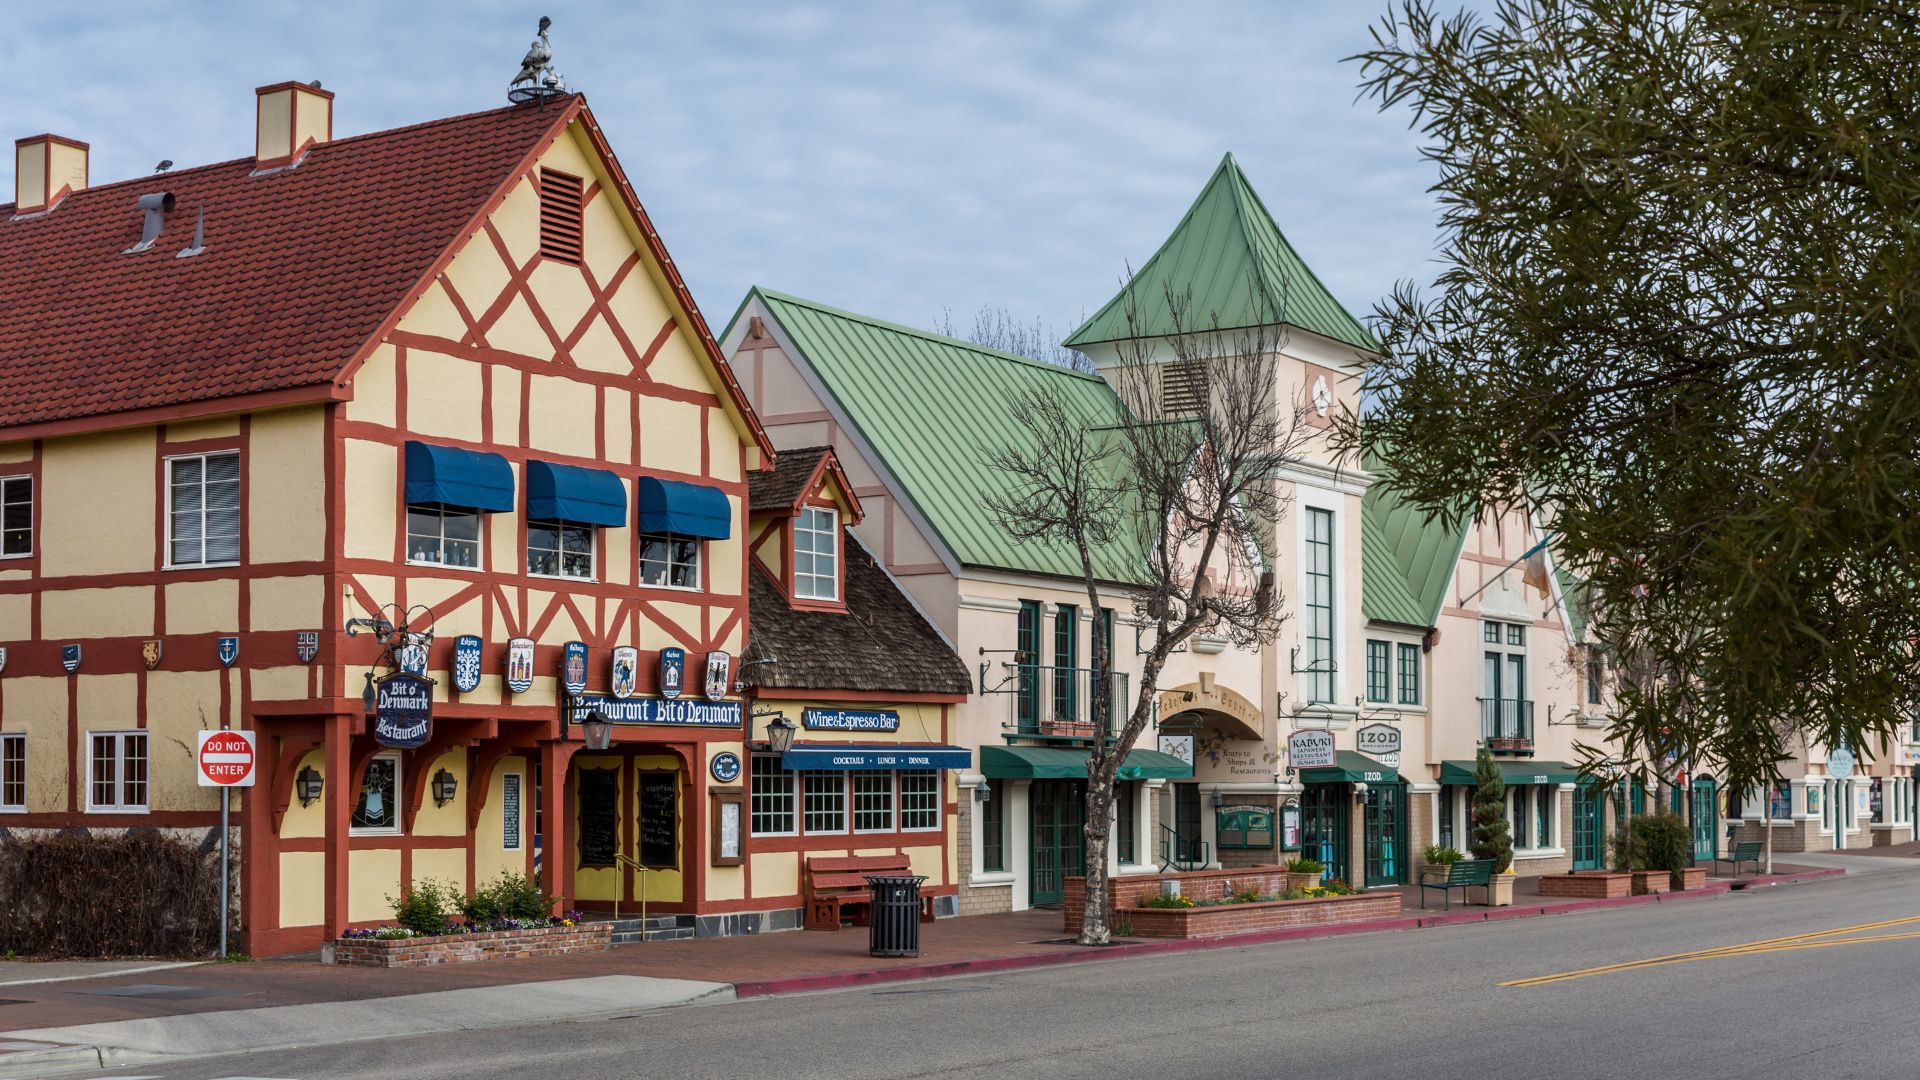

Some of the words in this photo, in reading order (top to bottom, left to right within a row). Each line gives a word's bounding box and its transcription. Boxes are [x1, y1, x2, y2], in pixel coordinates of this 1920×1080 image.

[391, 682, 407, 695] Bit
[378, 689, 428, 710] Denmark
[655, 700, 676, 722] Bit
[686, 700, 741, 723] Denmark
[880, 713, 896, 729] Bar
[376, 717, 427, 740] Restaurant
[1360, 732, 1398, 743] IZOD
[207, 741, 222, 751] DO
[226, 741, 246, 751] NOT
[1292, 737, 1331, 750] KABUKI
[1223, 748, 1242, 758] Entry
[1297, 746, 1326, 754] JAPANESE
[833, 757, 864, 765] COCKTAILS
[877, 757, 896, 765] LUNCH
[908, 757, 930, 765] DINNER
[1226, 758, 1247, 767] Shops
[209, 765, 244, 775] ENTER
[1230, 766, 1271, 775] Restaurants
